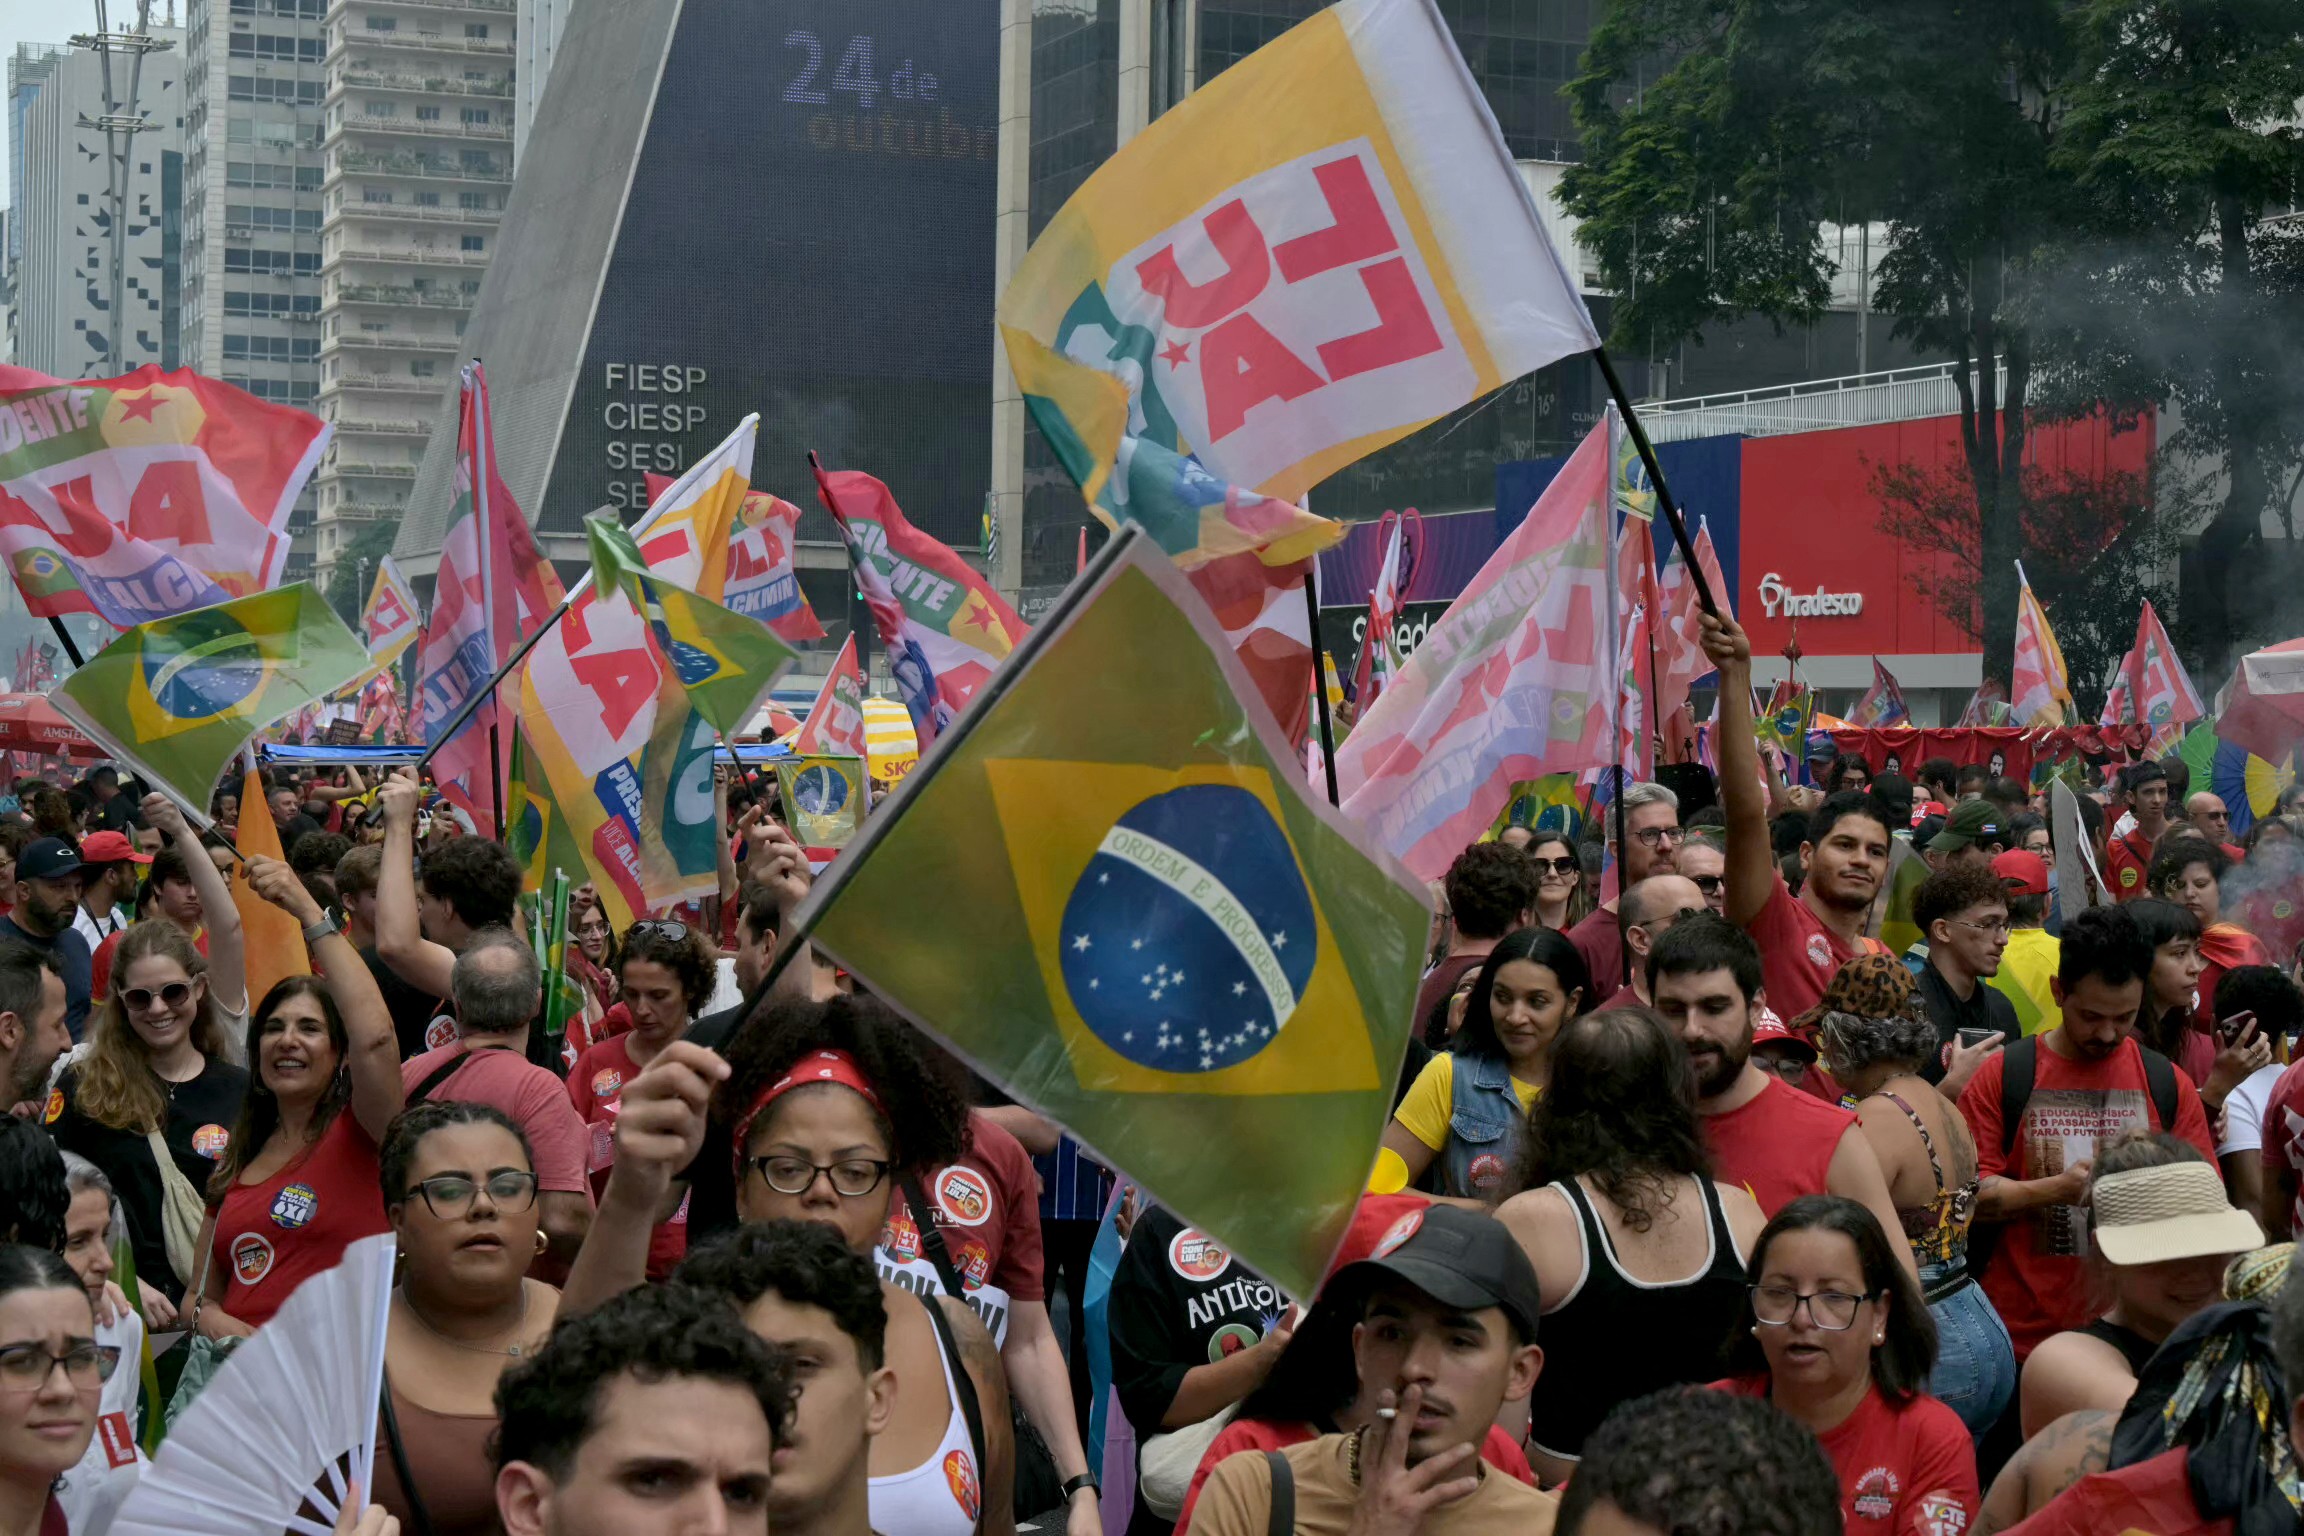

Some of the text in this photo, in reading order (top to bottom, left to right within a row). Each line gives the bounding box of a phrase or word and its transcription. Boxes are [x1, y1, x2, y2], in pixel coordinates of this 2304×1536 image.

[782, 29, 938, 108] 24 de
[808, 106, 998, 160] outubr
[605, 363, 707, 393] FIESP
[604, 402, 707, 432] CIESP
[607, 440, 683, 471] SESI
[1783, 585, 1863, 617] bradesco
[883, 760, 919, 777] SKO
[1111, 831, 1292, 1012] ORDEM E PROGRESSO
[2029, 1107, 2137, 1119] A EDUCAÇÃO FÍSICA
[2040, 1118, 2049, 1127] O
[2051, 1118, 2121, 1128] PASSAPORTE
[2031, 1128, 2060, 1137] PARA
[2062, 1128, 2071, 1137] O
[1187, 1281, 1290, 1329] ANTICOL
